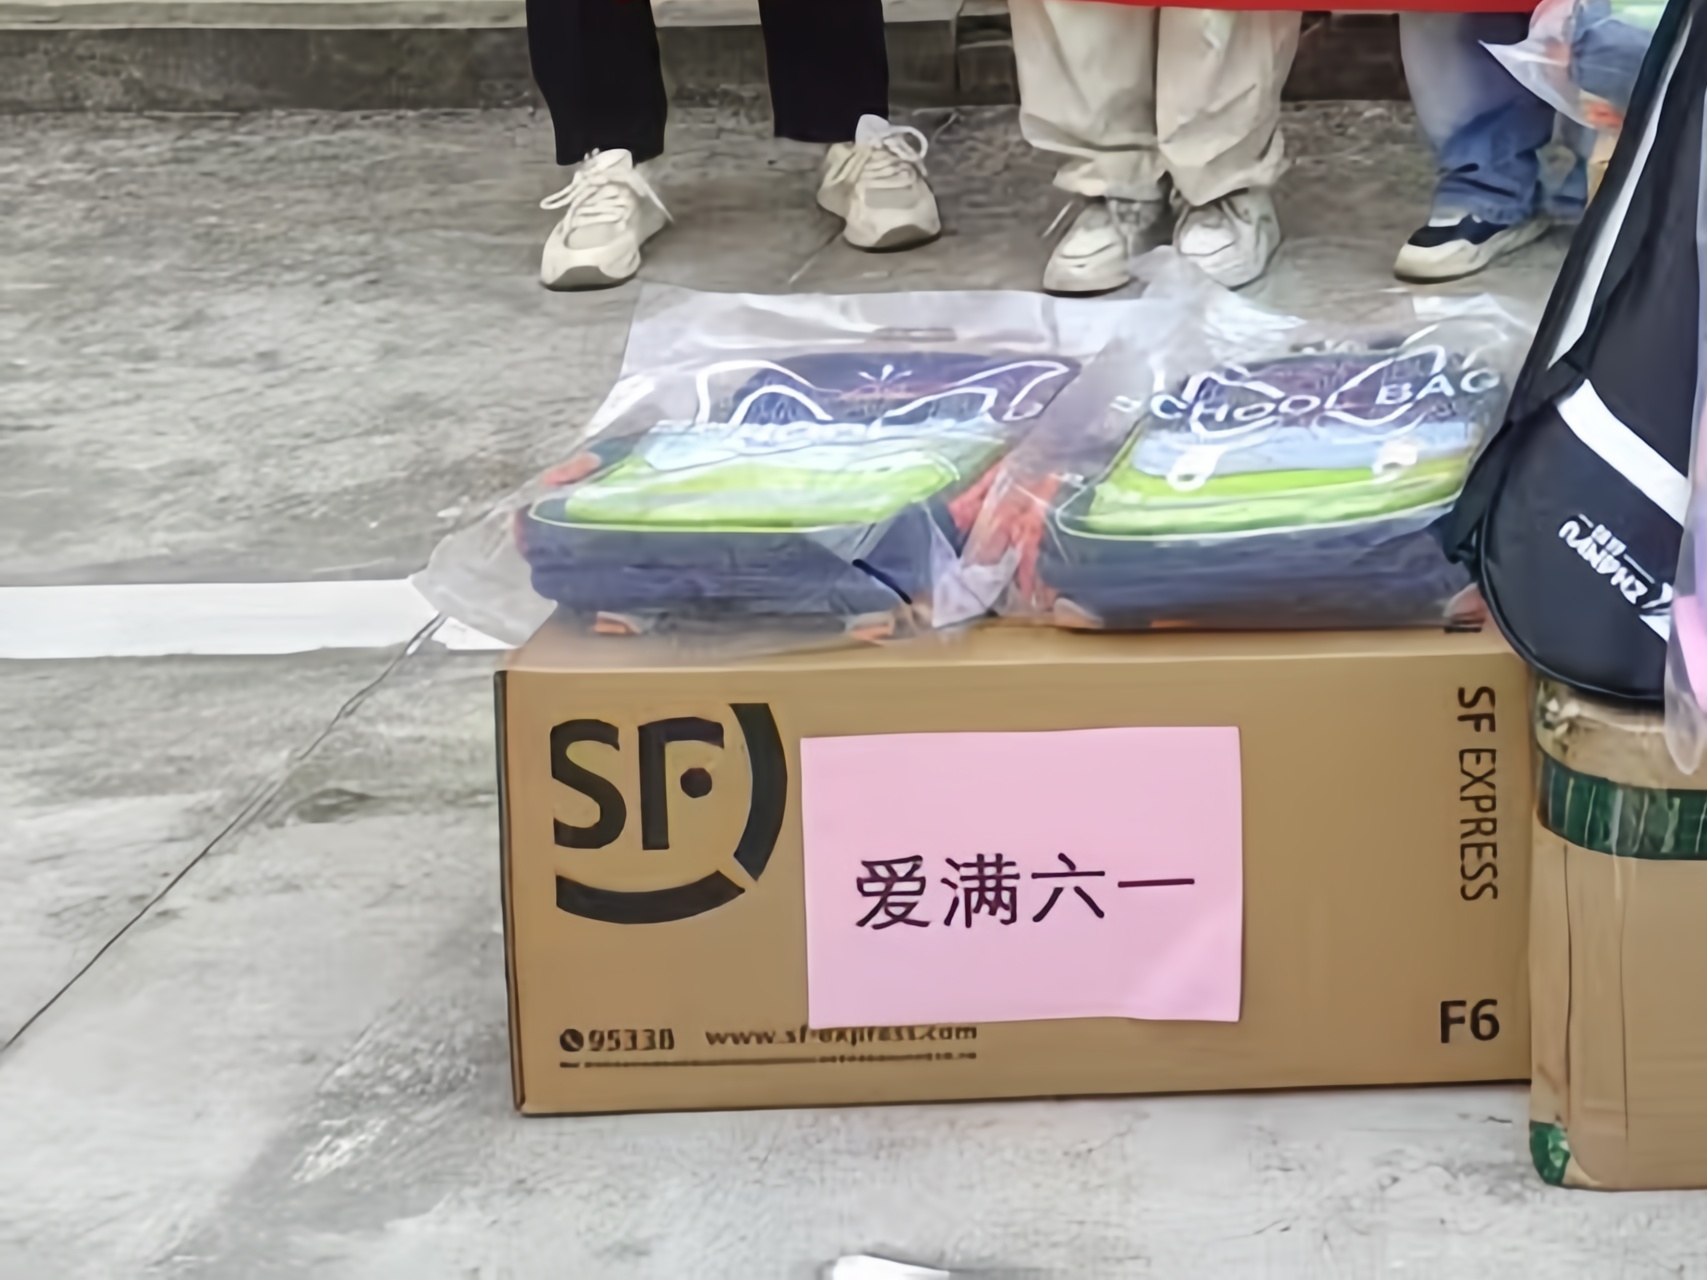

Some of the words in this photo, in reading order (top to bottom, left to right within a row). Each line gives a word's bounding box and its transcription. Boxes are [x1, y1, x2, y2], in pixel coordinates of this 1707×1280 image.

[1456, 685, 1497, 733] SF
[1458, 747, 1499, 902] EXPRESS
[854, 851, 1197, 931] 爱满六一
[1439, 998, 1501, 1044] F6
